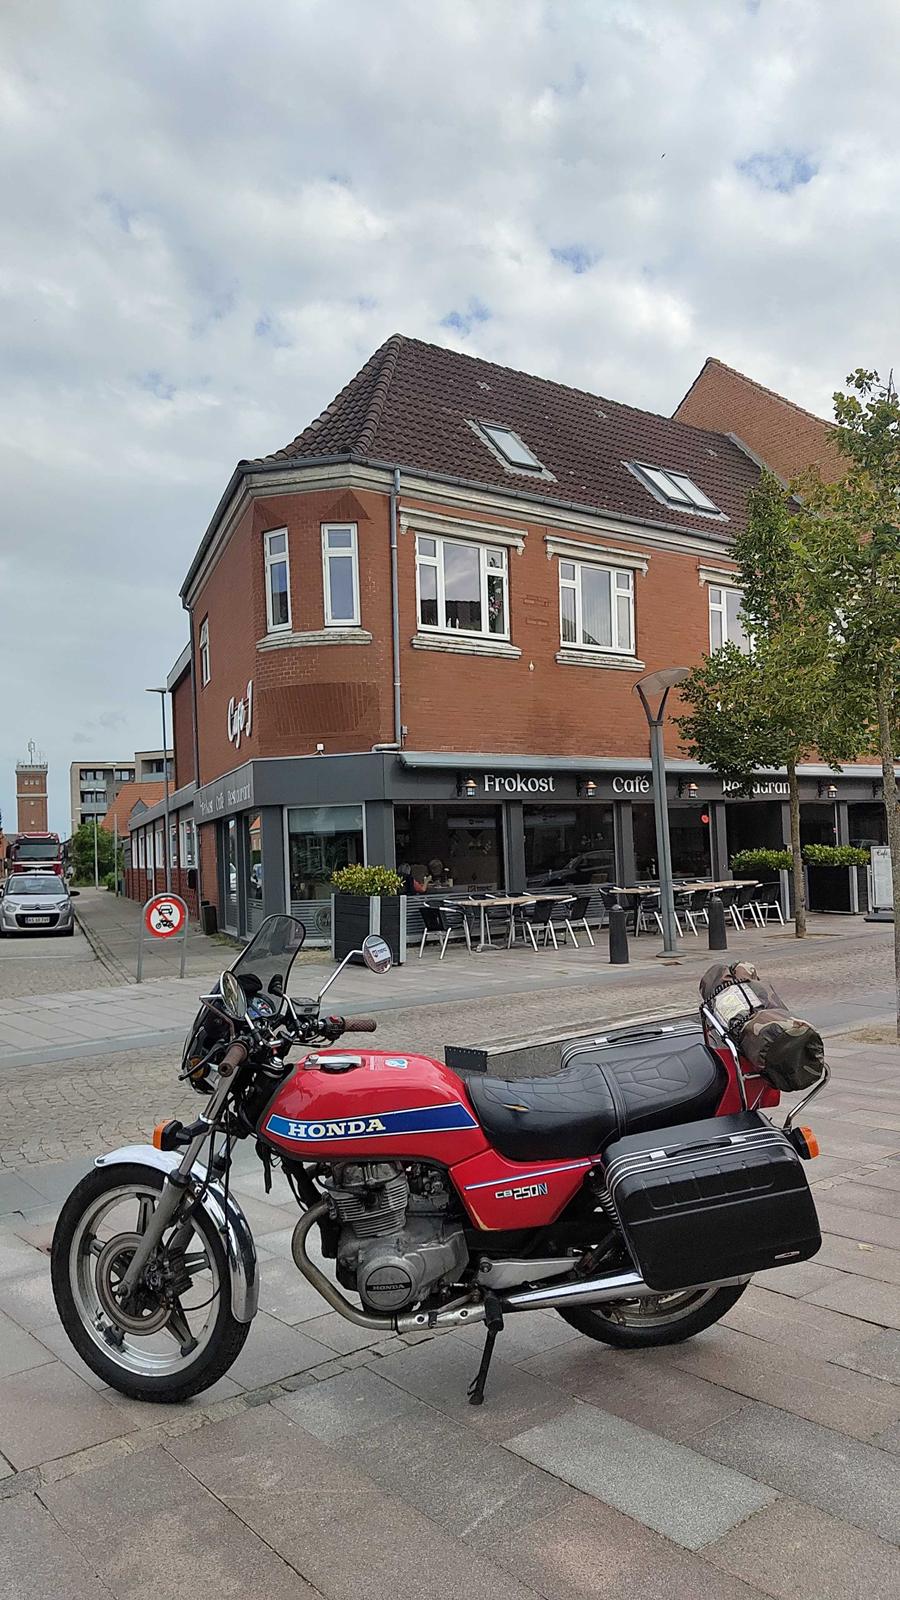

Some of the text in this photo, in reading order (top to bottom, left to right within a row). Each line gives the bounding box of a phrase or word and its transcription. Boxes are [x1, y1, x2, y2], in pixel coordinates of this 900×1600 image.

[484, 773, 556, 793] Frokost
[612, 775, 651, 793] Café
[287, 1118, 387, 1138] HONDA
[494, 1182, 549, 1200] CB 250N
[372, 1283, 406, 1291] HONDA
